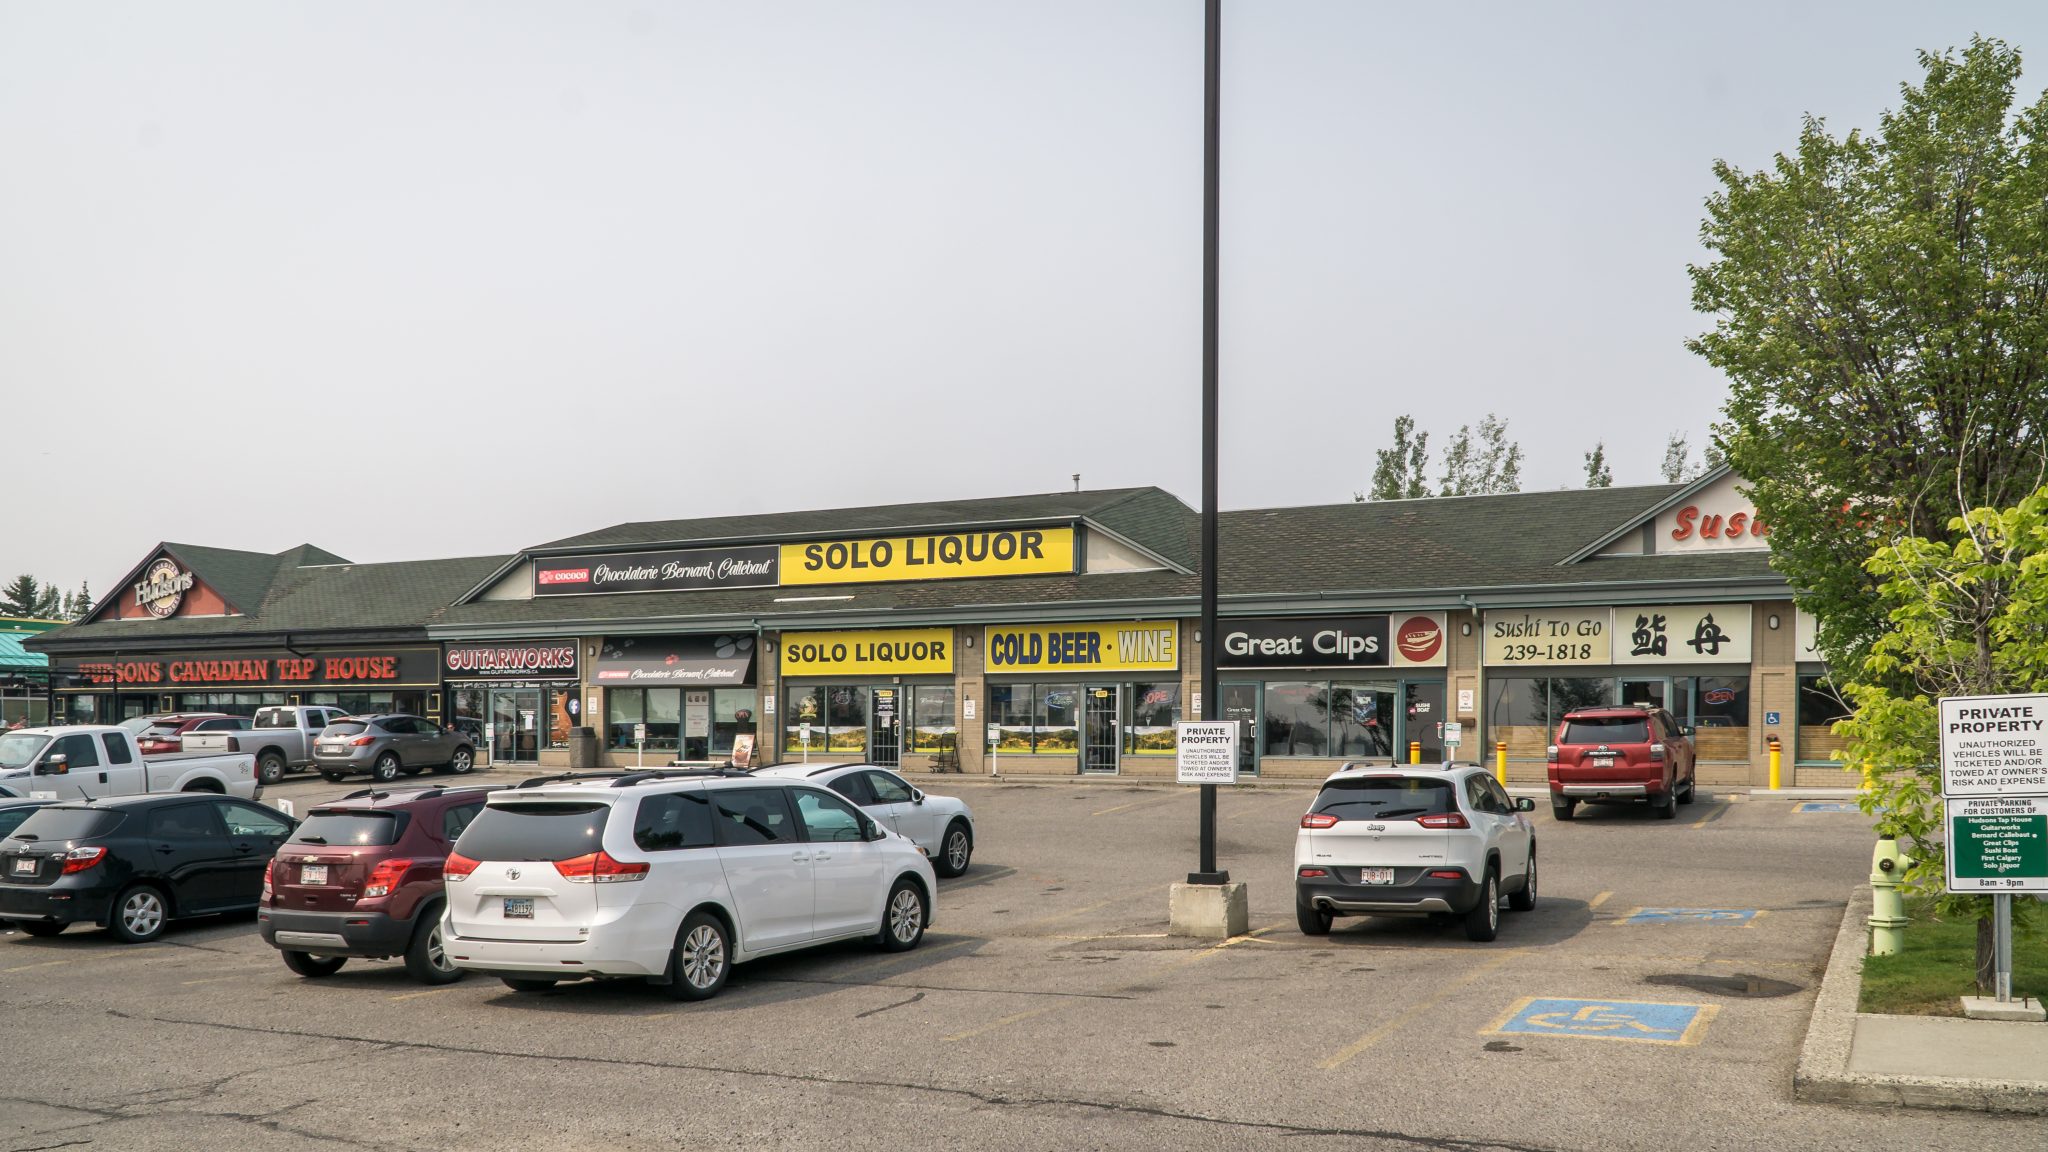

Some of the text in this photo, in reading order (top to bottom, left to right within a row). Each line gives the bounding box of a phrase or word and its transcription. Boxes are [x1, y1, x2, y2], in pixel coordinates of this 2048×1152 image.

[1672, 505, 1774, 541] Sush
[804, 531, 1044, 571] SOLO LIQUOR
[554, 572, 587, 581] cococo
[594, 558, 771, 585] Chocolaterie Bernard Callebaut
[1494, 614, 1602, 639] Sushi To Go
[788, 641, 946, 663] SOLO LIQUOR
[990, 629, 1172, 666] COLD BEER WINE
[1224, 630, 1379, 660] Great Clips
[1503, 643, 1592, 661] 239-1818
[447, 646, 574, 670] GUITARWORKS
[169, 659, 268, 682] CANADIAN
[277, 658, 315, 680] TAP
[324, 656, 398, 680] HOUSE
[1145, 690, 1168, 704] OPE
[1704, 691, 1734, 701] OPEN
[1959, 706, 2033, 720] PRIVATE
[1950, 720, 2044, 734] PROPERTY
[1959, 740, 2036, 748] UNAUTHORIZED
[1953, 750, 2000, 758] VEHICLES
[1954, 759, 2002, 768] TICKETED
[1367, 824, 1385, 832] Jeep
